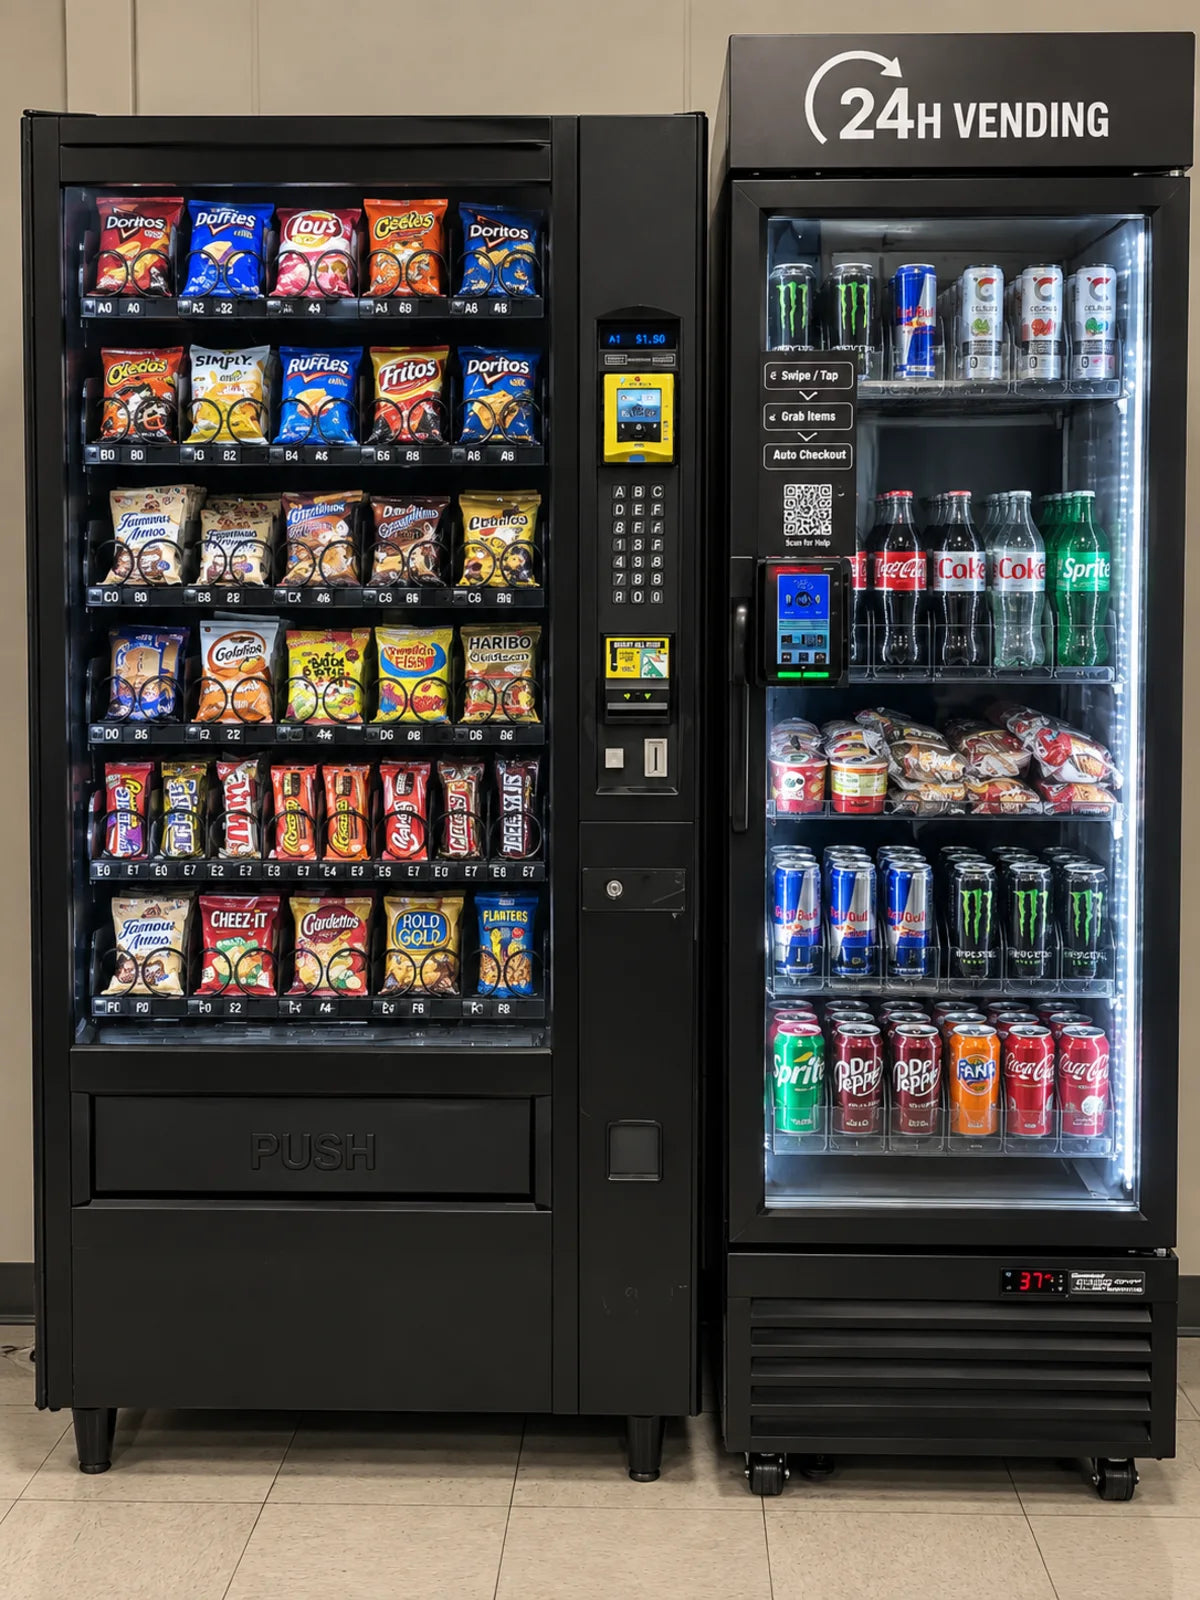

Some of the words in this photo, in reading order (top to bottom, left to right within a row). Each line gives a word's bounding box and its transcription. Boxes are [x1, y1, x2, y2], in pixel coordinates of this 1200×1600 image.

[839, 87, 941, 139] 24H
[953, 102, 1109, 138] VENDING
[470, 224, 529, 239] Doritos
[467, 358, 529, 373] Doritos
[380, 360, 435, 389] Fritos
[781, 370, 811, 382] Swipe
[820, 370, 838, 382] Tap
[781, 411, 804, 422] Grab
[807, 411, 836, 422] Items
[773, 450, 797, 460] Auto
[799, 449, 847, 460] Checkout
[615, 486, 625, 497] A
[634, 486, 643, 497] B
[653, 486, 662, 497] C
[615, 504, 624, 515] D
[634, 504, 642, 515] E
[653, 504, 661, 515] F
[615, 556, 623, 567] 4
[1063, 558, 1111, 584] Sprite
[616, 574, 624, 584] 7
[634, 574, 642, 584] 8
[634, 591, 642, 602] 0
[653, 591, 660, 602] 0
[469, 636, 531, 650] HARIBO
[250, 1133, 376, 1171] PUSH
